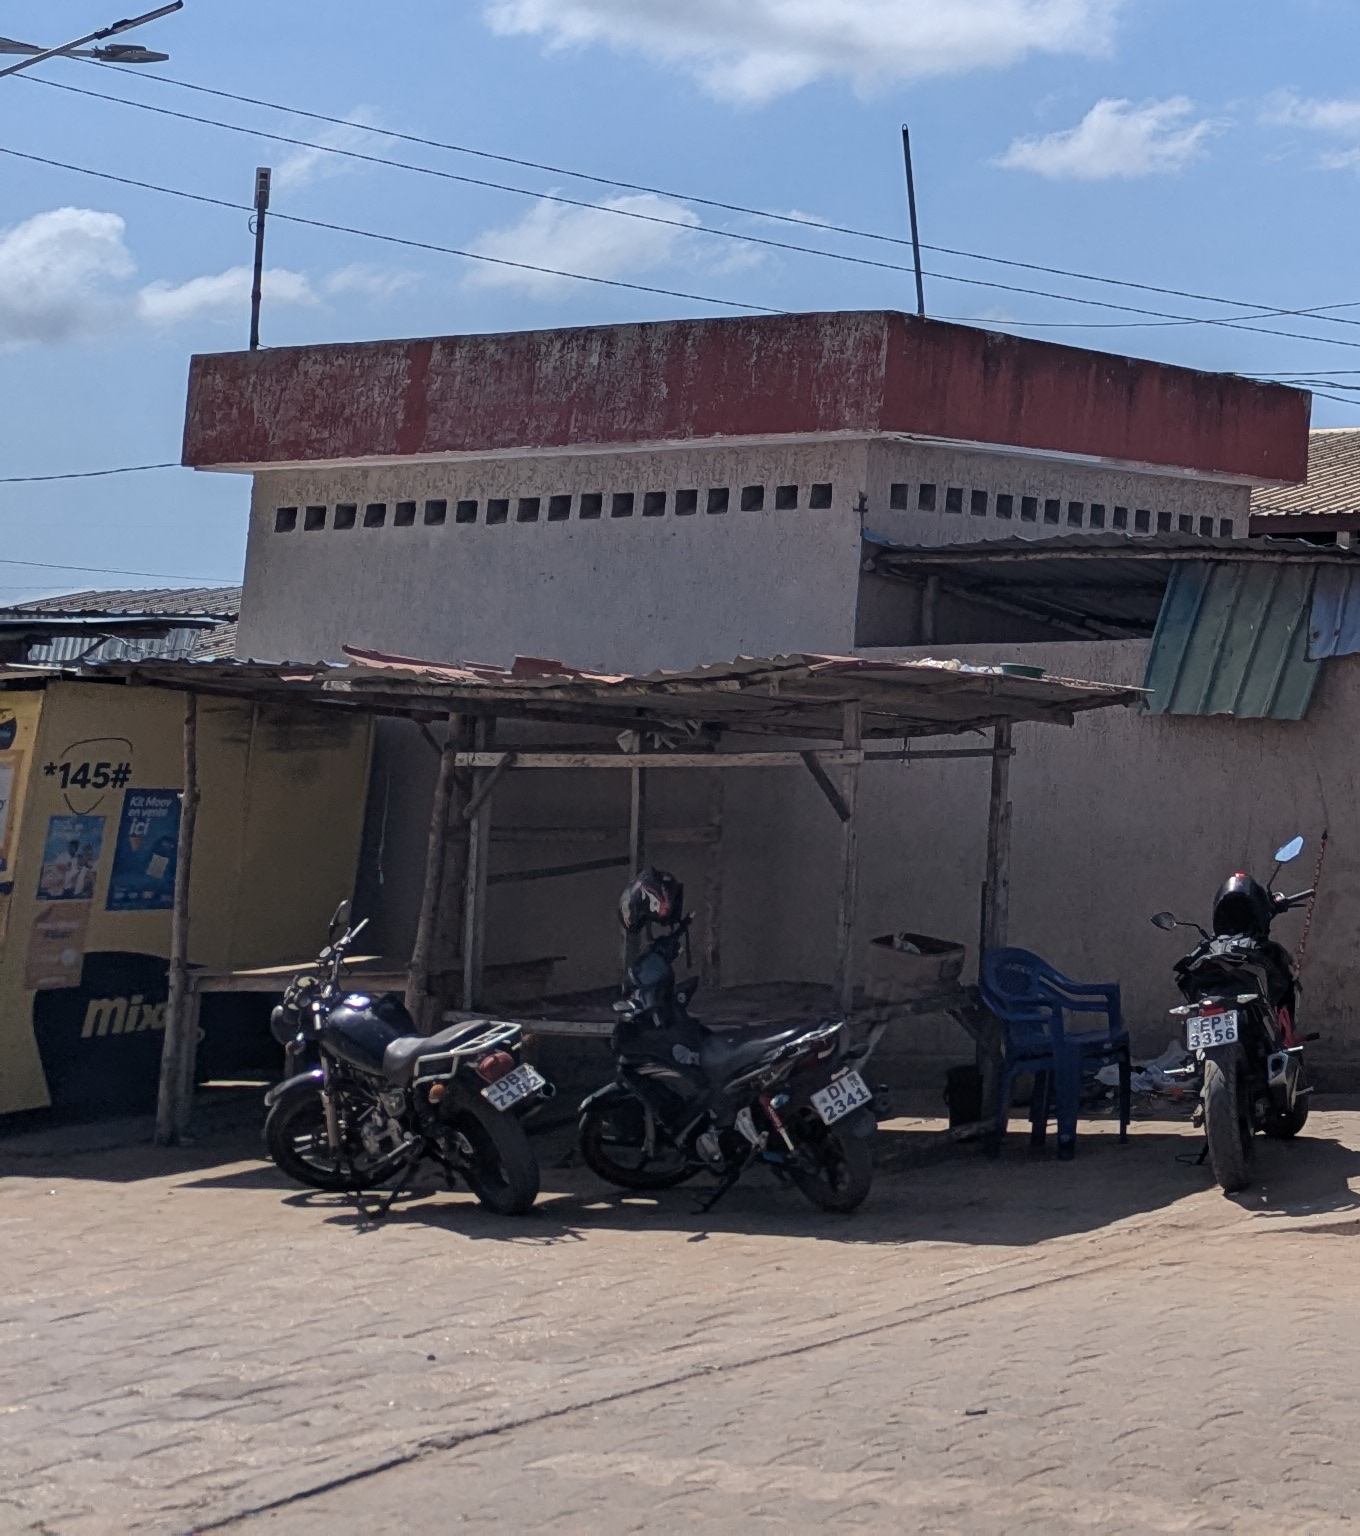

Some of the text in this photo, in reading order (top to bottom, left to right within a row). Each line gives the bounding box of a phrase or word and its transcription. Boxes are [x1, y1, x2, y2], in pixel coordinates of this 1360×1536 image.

[130, 818, 151, 834] ici
[1200, 1016, 1221, 1033] EP
[1191, 1027, 1235, 1047] 3356
[495, 1073, 520, 1093] DB
[827, 1081, 846, 1100] DI
[824, 1087, 868, 1121] 2341
